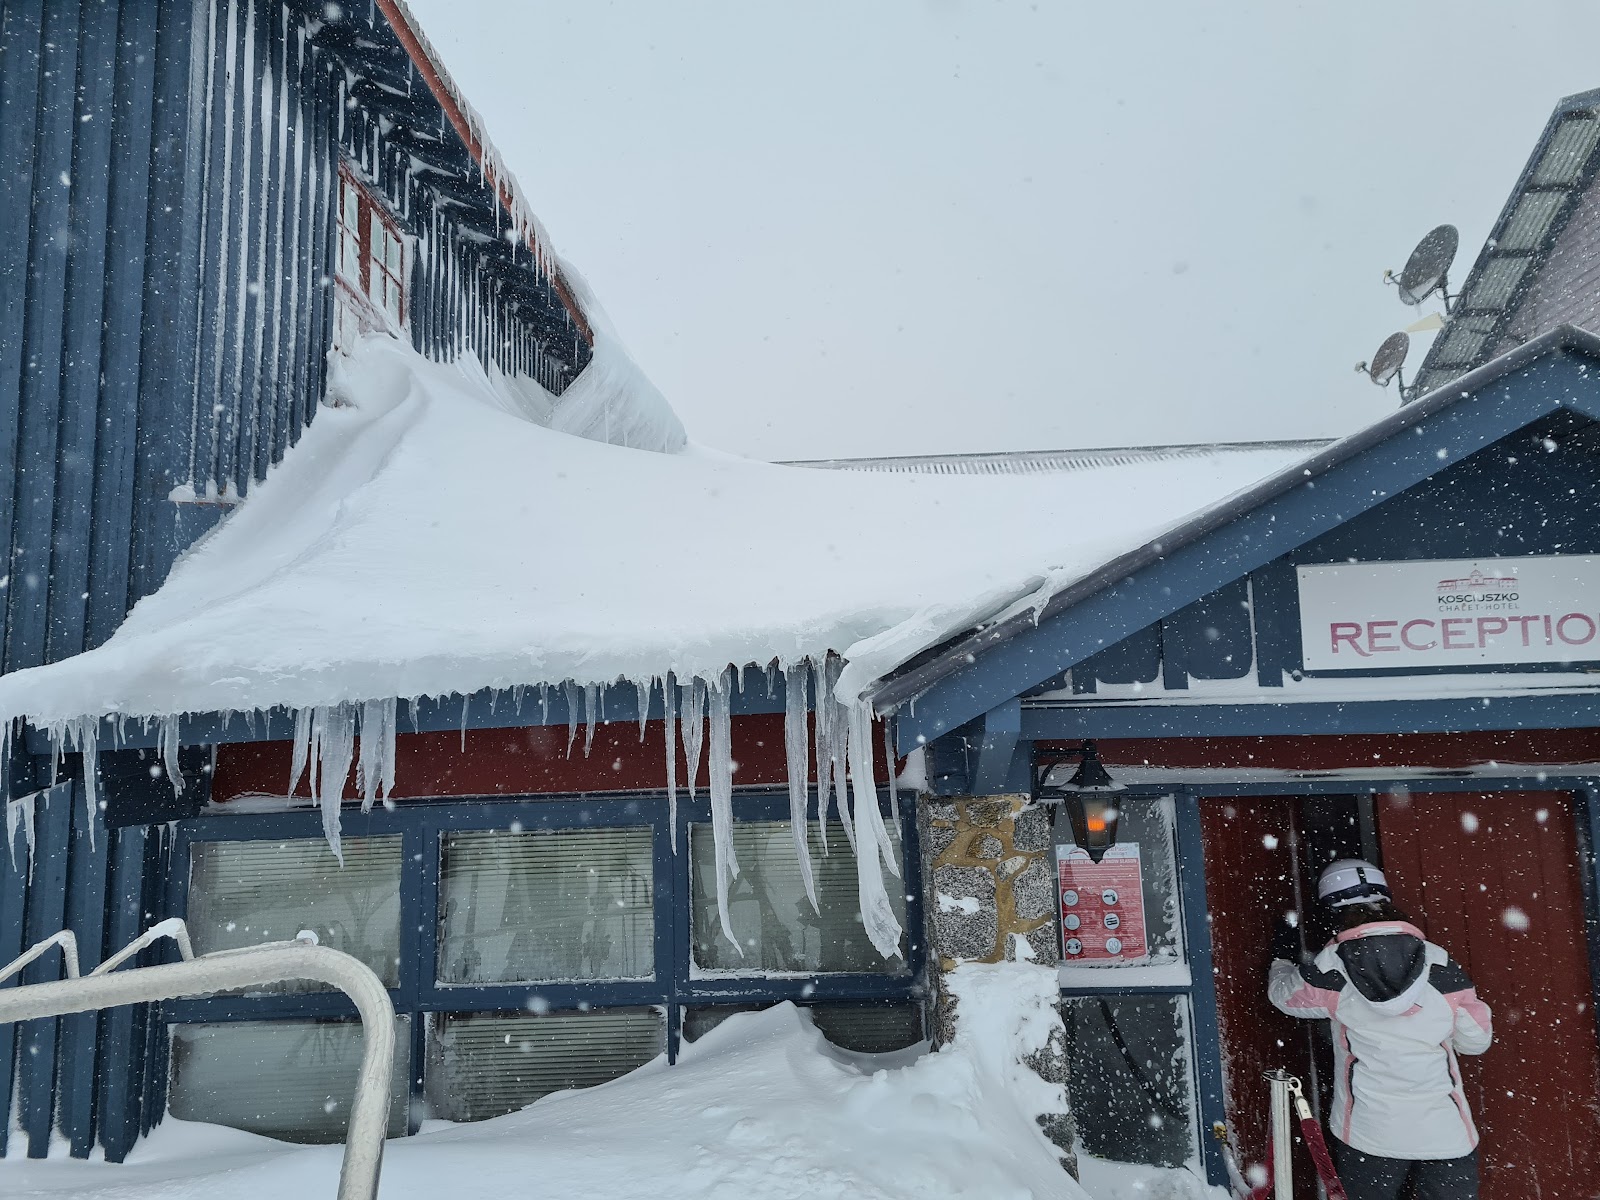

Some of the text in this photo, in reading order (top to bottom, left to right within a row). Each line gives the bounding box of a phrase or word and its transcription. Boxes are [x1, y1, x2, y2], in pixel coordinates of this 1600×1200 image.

[1437, 592, 1520, 605] KOSCIUSZKO
[1438, 602, 1520, 612] CHALET-HOTEL
[1330, 612, 1600, 657] RECEPTIO
